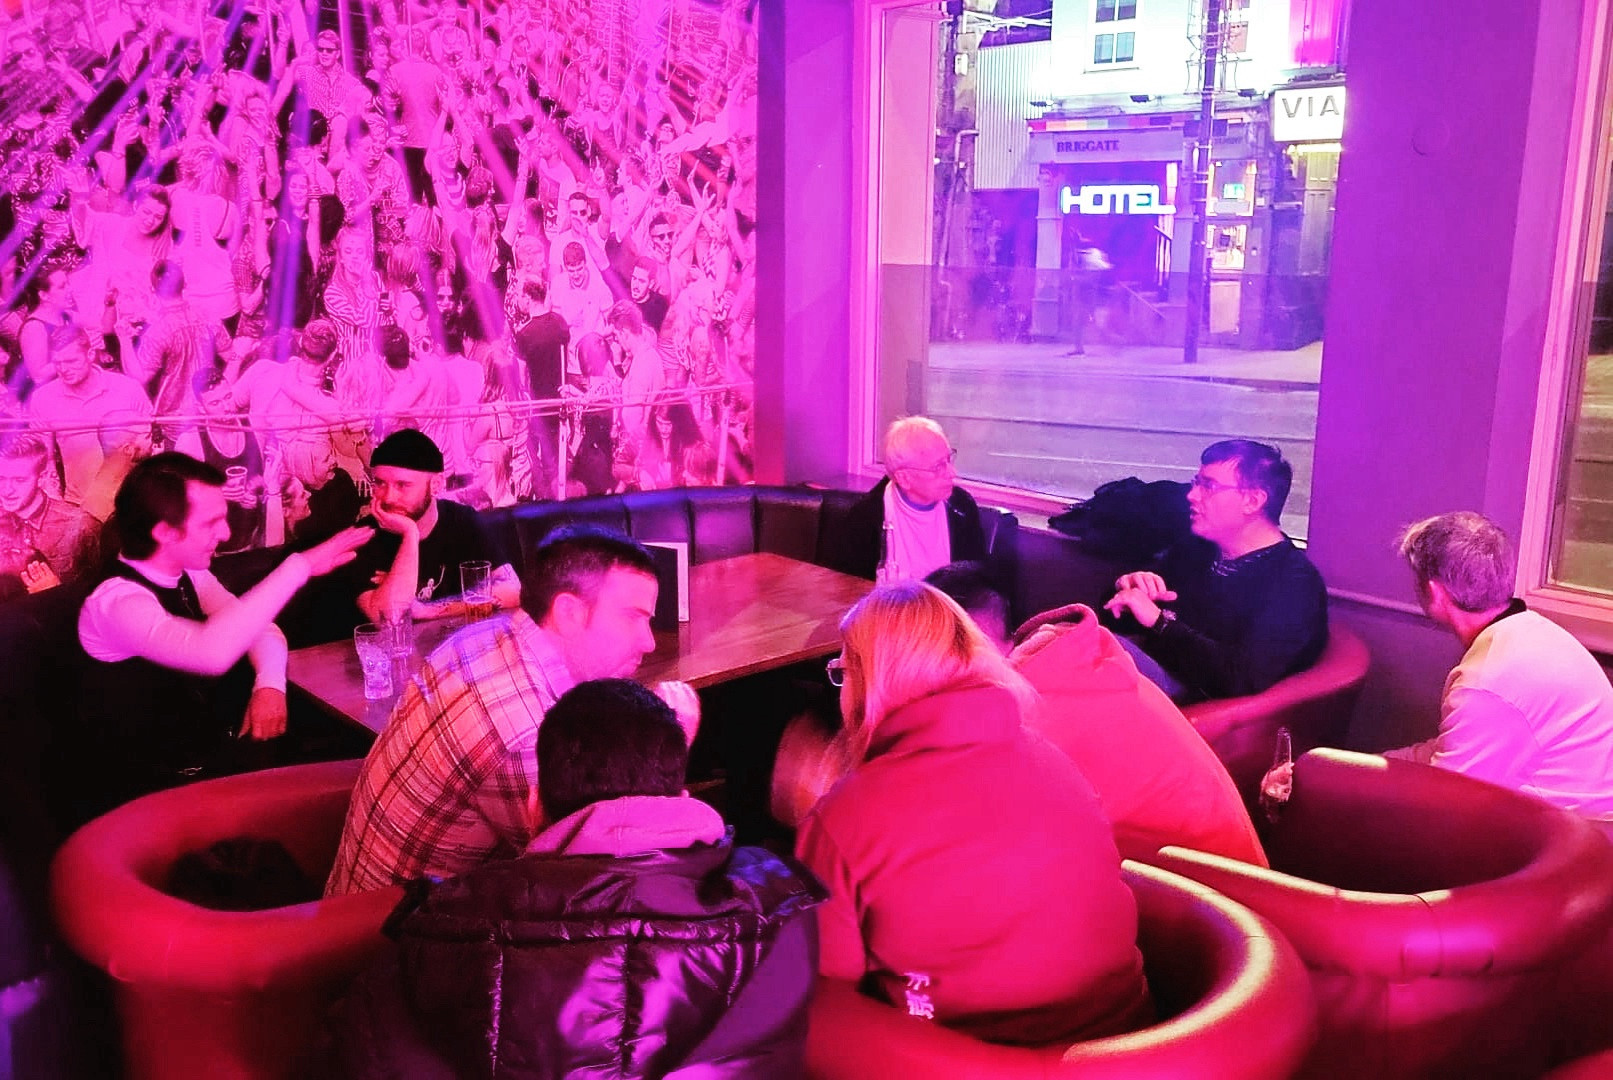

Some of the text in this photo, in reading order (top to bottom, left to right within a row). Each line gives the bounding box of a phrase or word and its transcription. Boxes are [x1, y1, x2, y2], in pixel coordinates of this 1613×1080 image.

[1281, 95, 1340, 118] VIA
[1056, 140, 1120, 153] BRIGGATE
[1060, 184, 1177, 215] HOTEL
